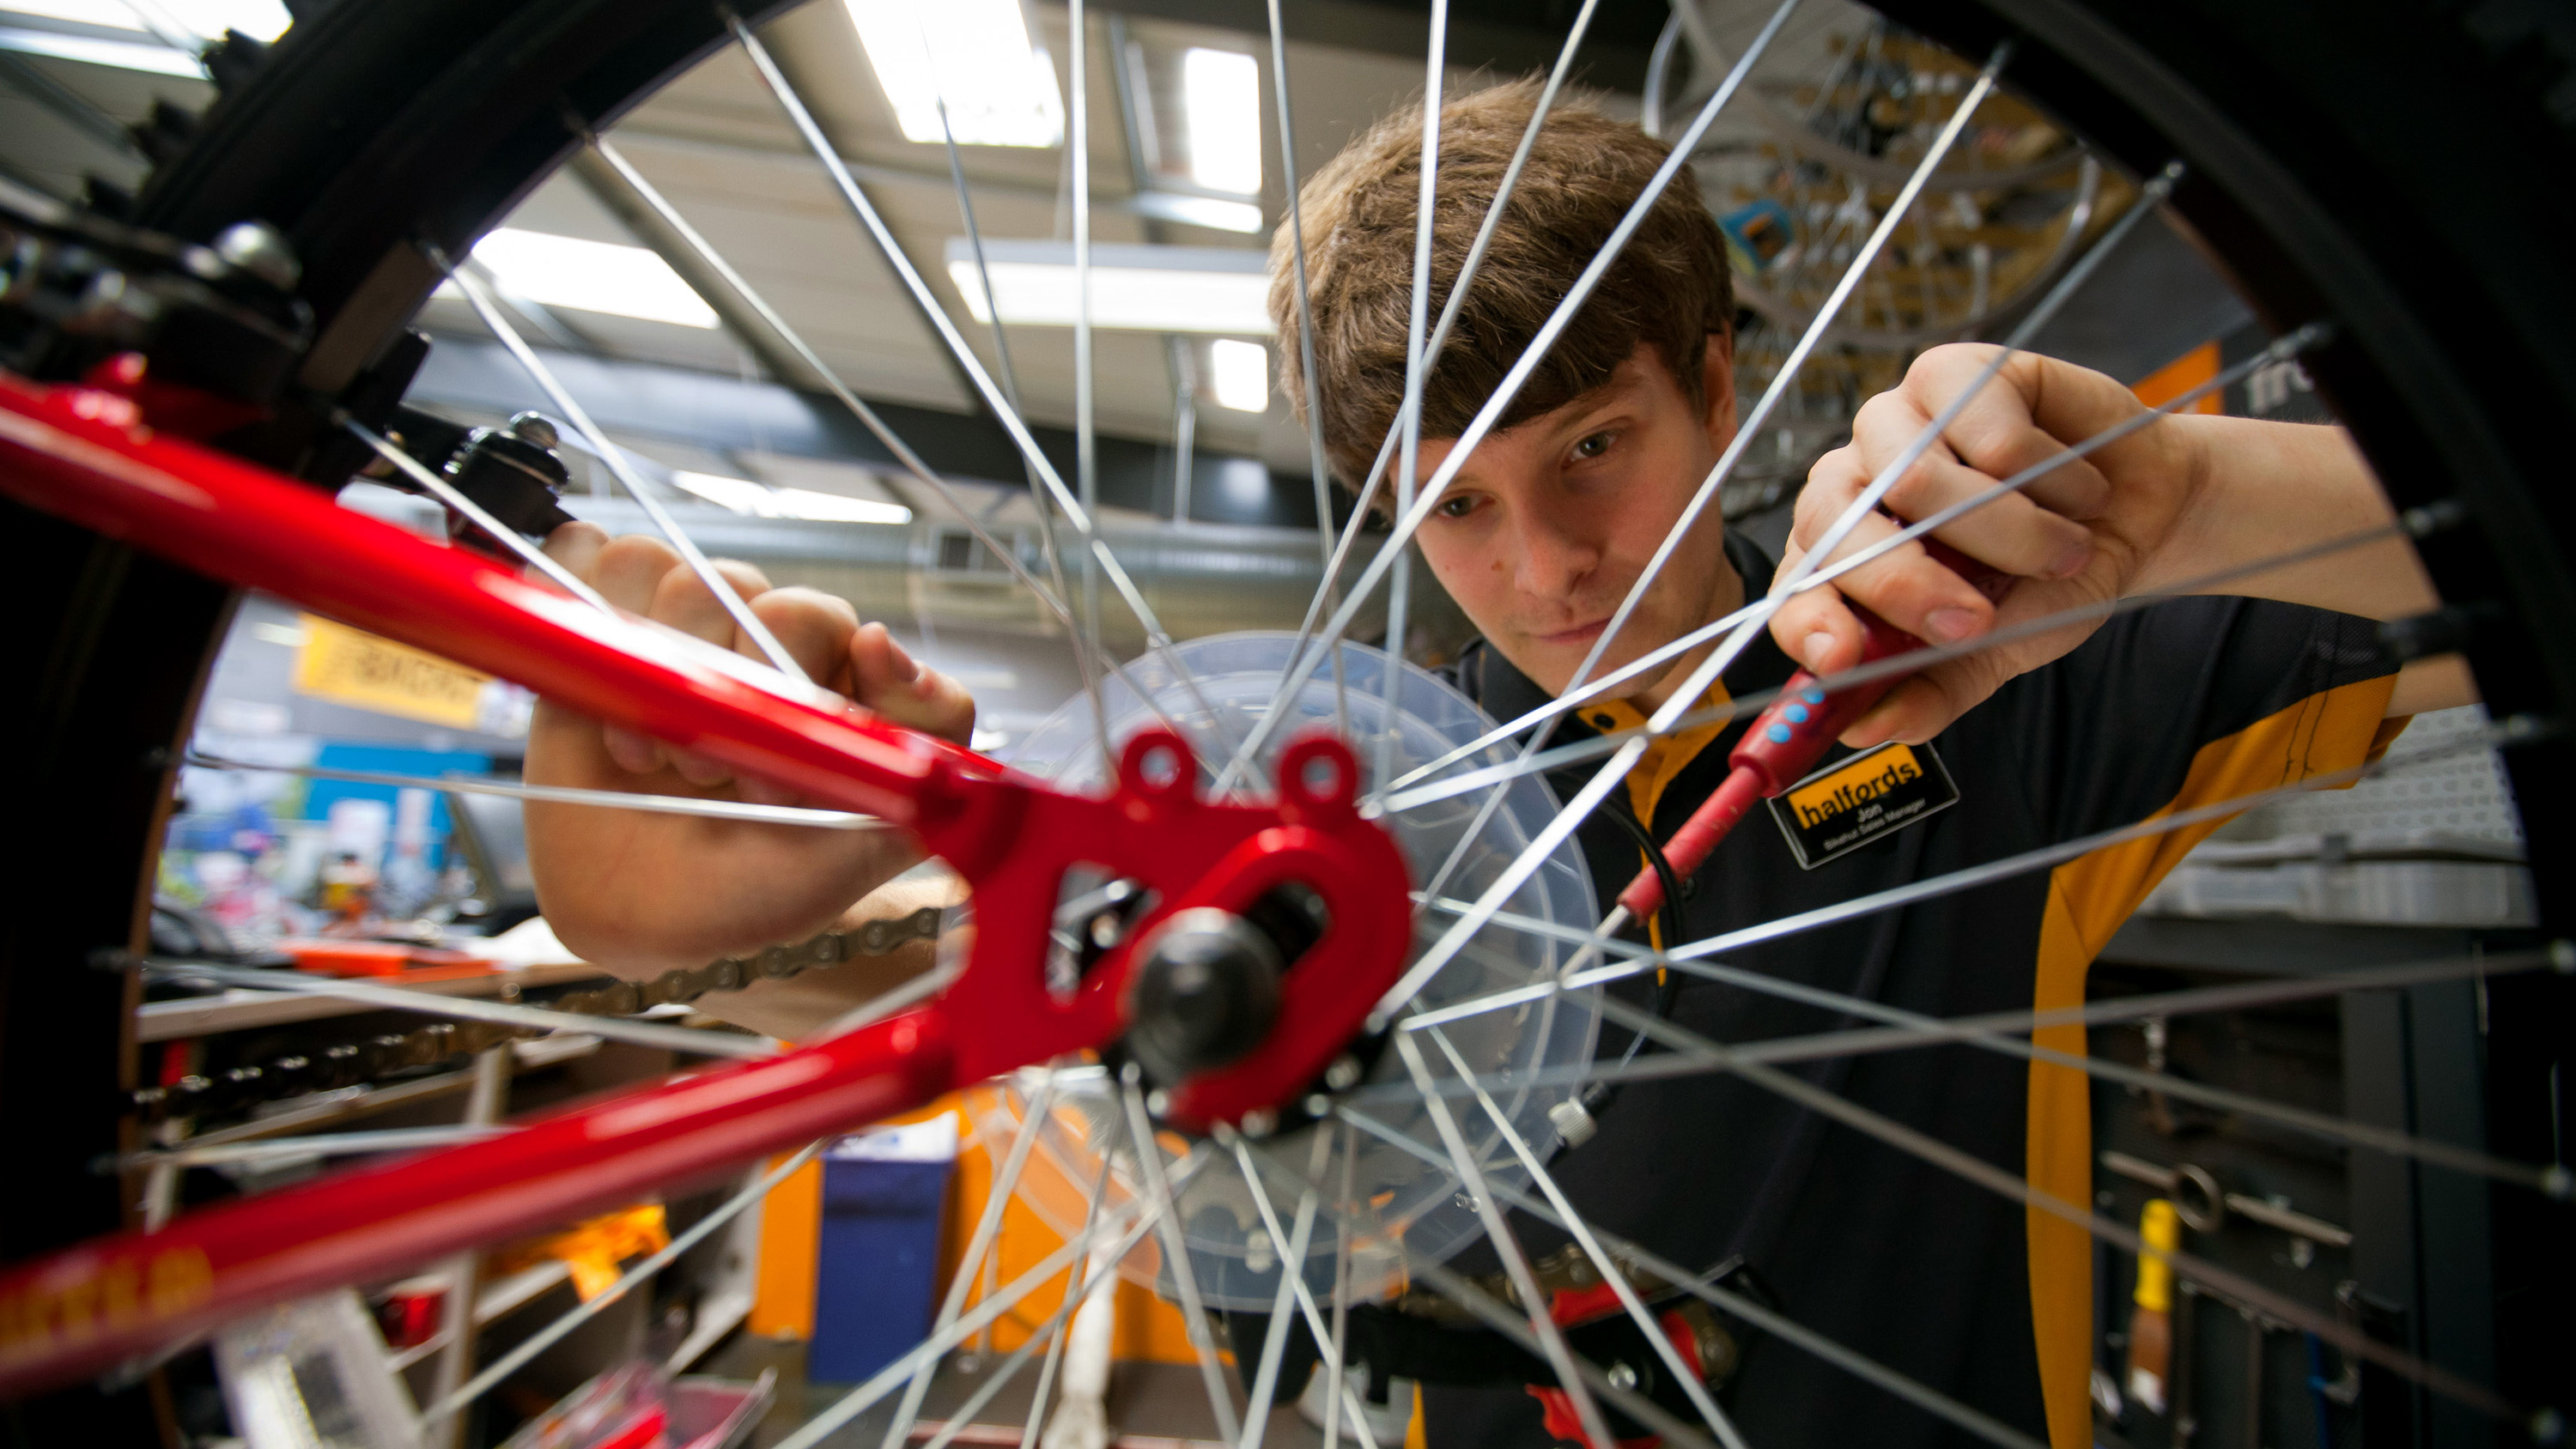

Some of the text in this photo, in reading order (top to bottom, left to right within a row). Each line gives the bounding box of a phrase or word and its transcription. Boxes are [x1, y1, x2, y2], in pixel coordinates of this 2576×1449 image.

[1801, 762, 1917, 828] halfords
[1858, 803, 1883, 822] Jon
[1860, 818, 1886, 835] Sales
[1886, 798, 1926, 822] Manager
